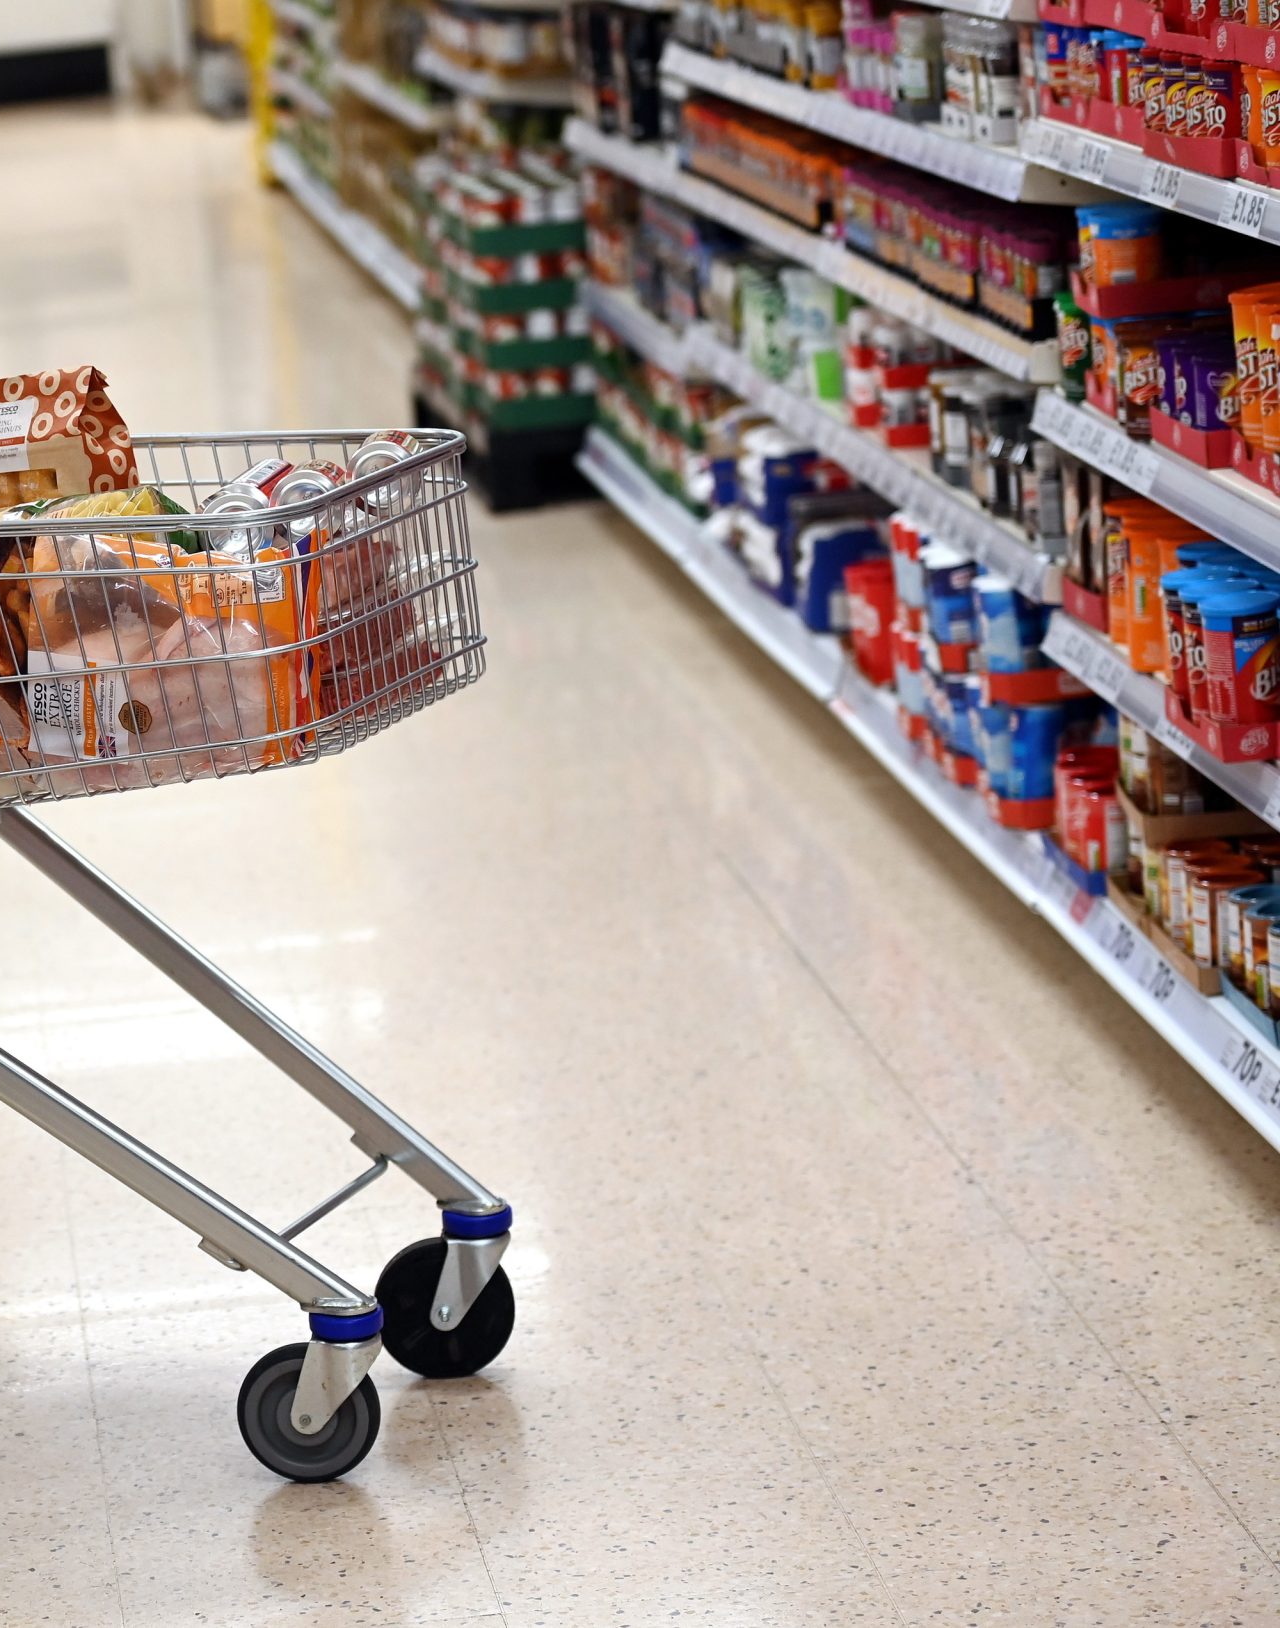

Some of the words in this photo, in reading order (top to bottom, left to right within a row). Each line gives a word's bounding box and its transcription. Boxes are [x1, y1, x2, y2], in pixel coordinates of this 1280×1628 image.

[1151, 164, 1181, 199] £1.85
[1231, 192, 1265, 229] £1.85
[34, 682, 44, 723] TESCO
[49, 684, 61, 728] EXTRA
[73, 679, 81, 712] CHICKEN
[73, 712, 82, 736] WHOLE
[1231, 1040, 1262, 1085] 70p
